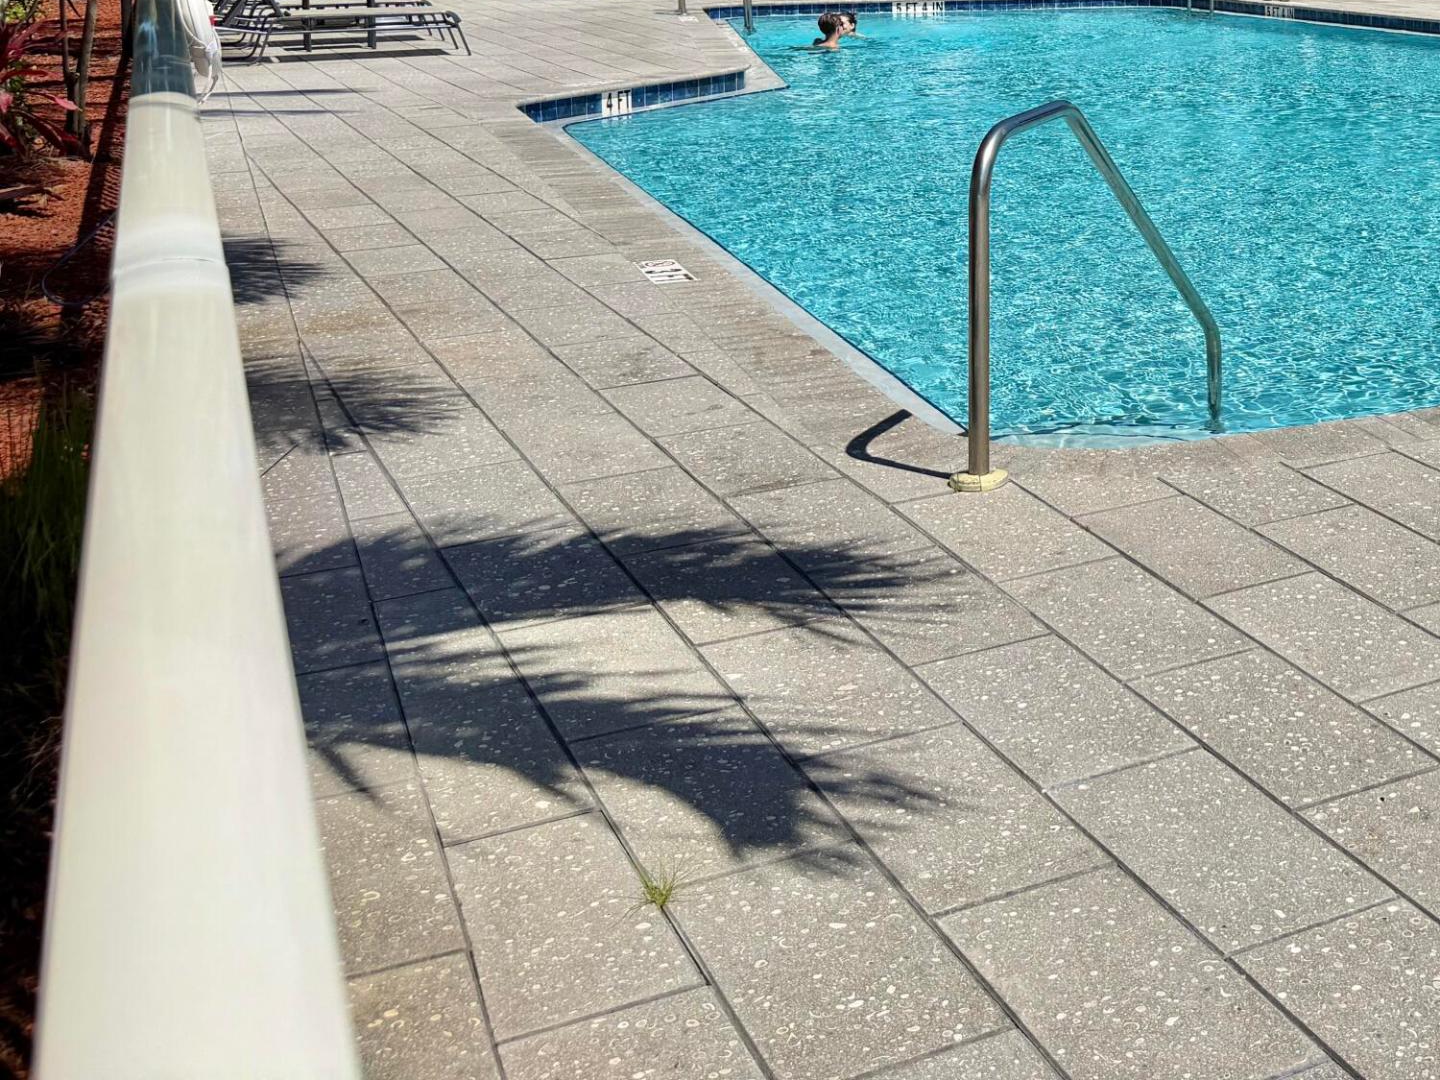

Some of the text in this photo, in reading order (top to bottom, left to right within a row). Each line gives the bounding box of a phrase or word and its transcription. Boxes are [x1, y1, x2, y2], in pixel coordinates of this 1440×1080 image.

[896, 2, 902, 12] 5
[906, 2, 918, 12] FT
[932, 1, 944, 11] IN
[606, 89, 631, 116] 4 FT
